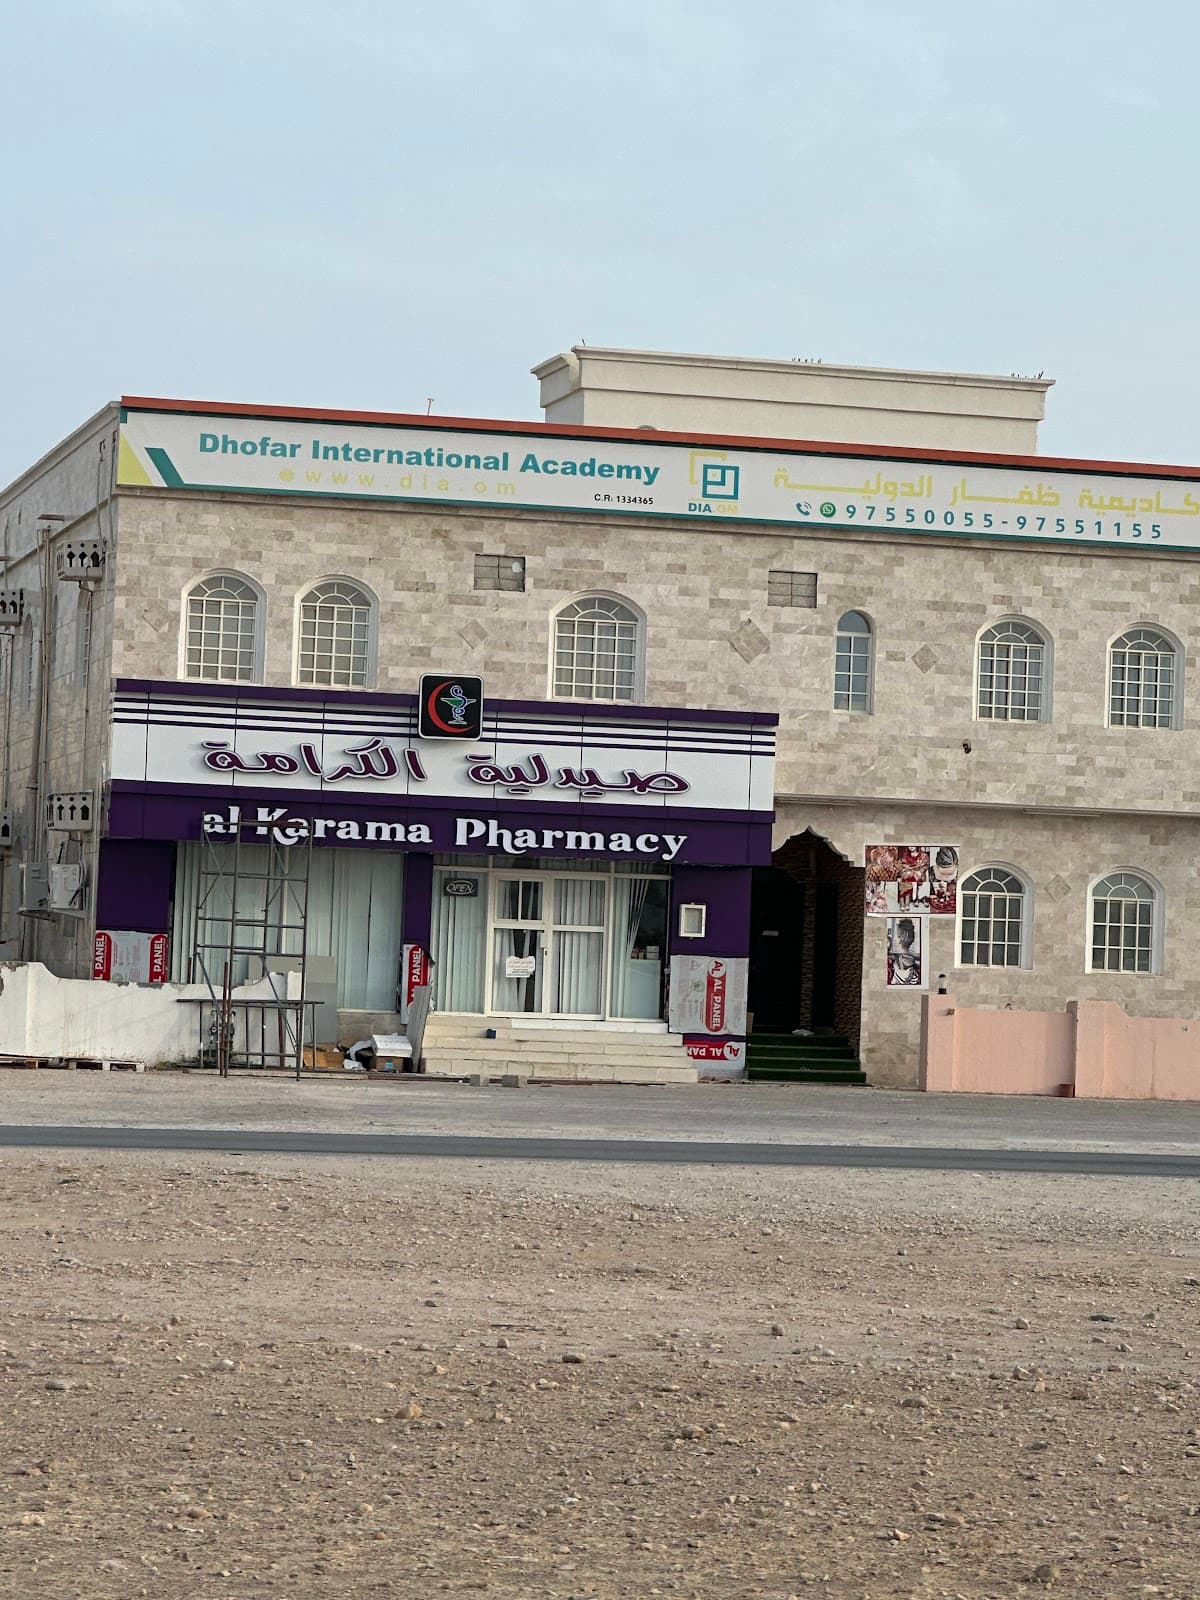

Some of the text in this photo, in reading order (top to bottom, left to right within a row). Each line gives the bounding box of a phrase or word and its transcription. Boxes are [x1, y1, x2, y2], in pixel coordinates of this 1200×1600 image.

[199, 433, 660, 486] Dhofar International Academy
[773, 466, 933, 502] الدولية
[950, 476, 1061, 507] ظفار
[201, 737, 691, 798] صيدلية الكرامة
[203, 805, 689, 861] al Karama Pharmacy
[95, 935, 105, 970] PANEL
[154, 938, 163, 972] PANEL
[412, 948, 421, 982] PANEL
[712, 979, 722, 1030] AL PANEL
